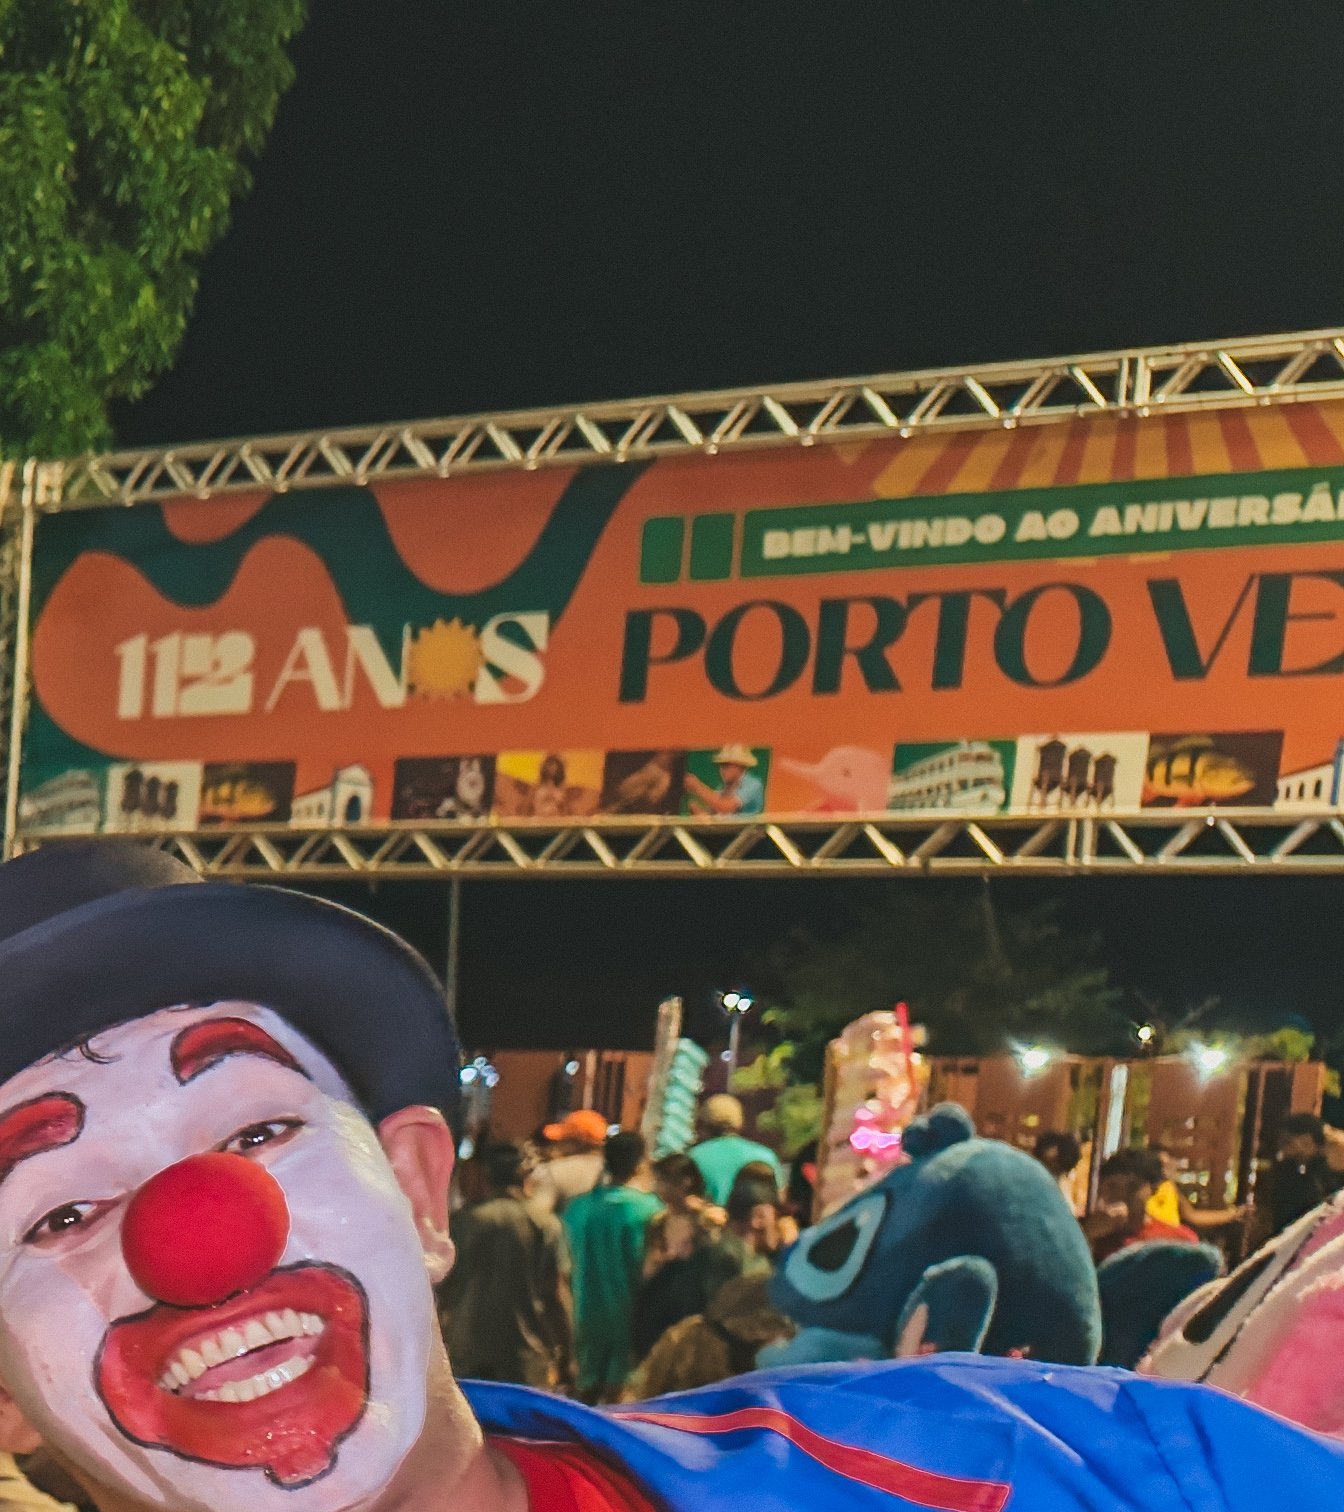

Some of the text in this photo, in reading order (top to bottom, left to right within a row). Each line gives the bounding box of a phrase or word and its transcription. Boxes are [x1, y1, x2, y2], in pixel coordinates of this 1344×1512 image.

[763, 513, 1006, 559] BEM-VINDO
[1014, 508, 1080, 542] AO
[114, 629, 256, 719] 112
[618, 581, 1112, 704] PORTO
